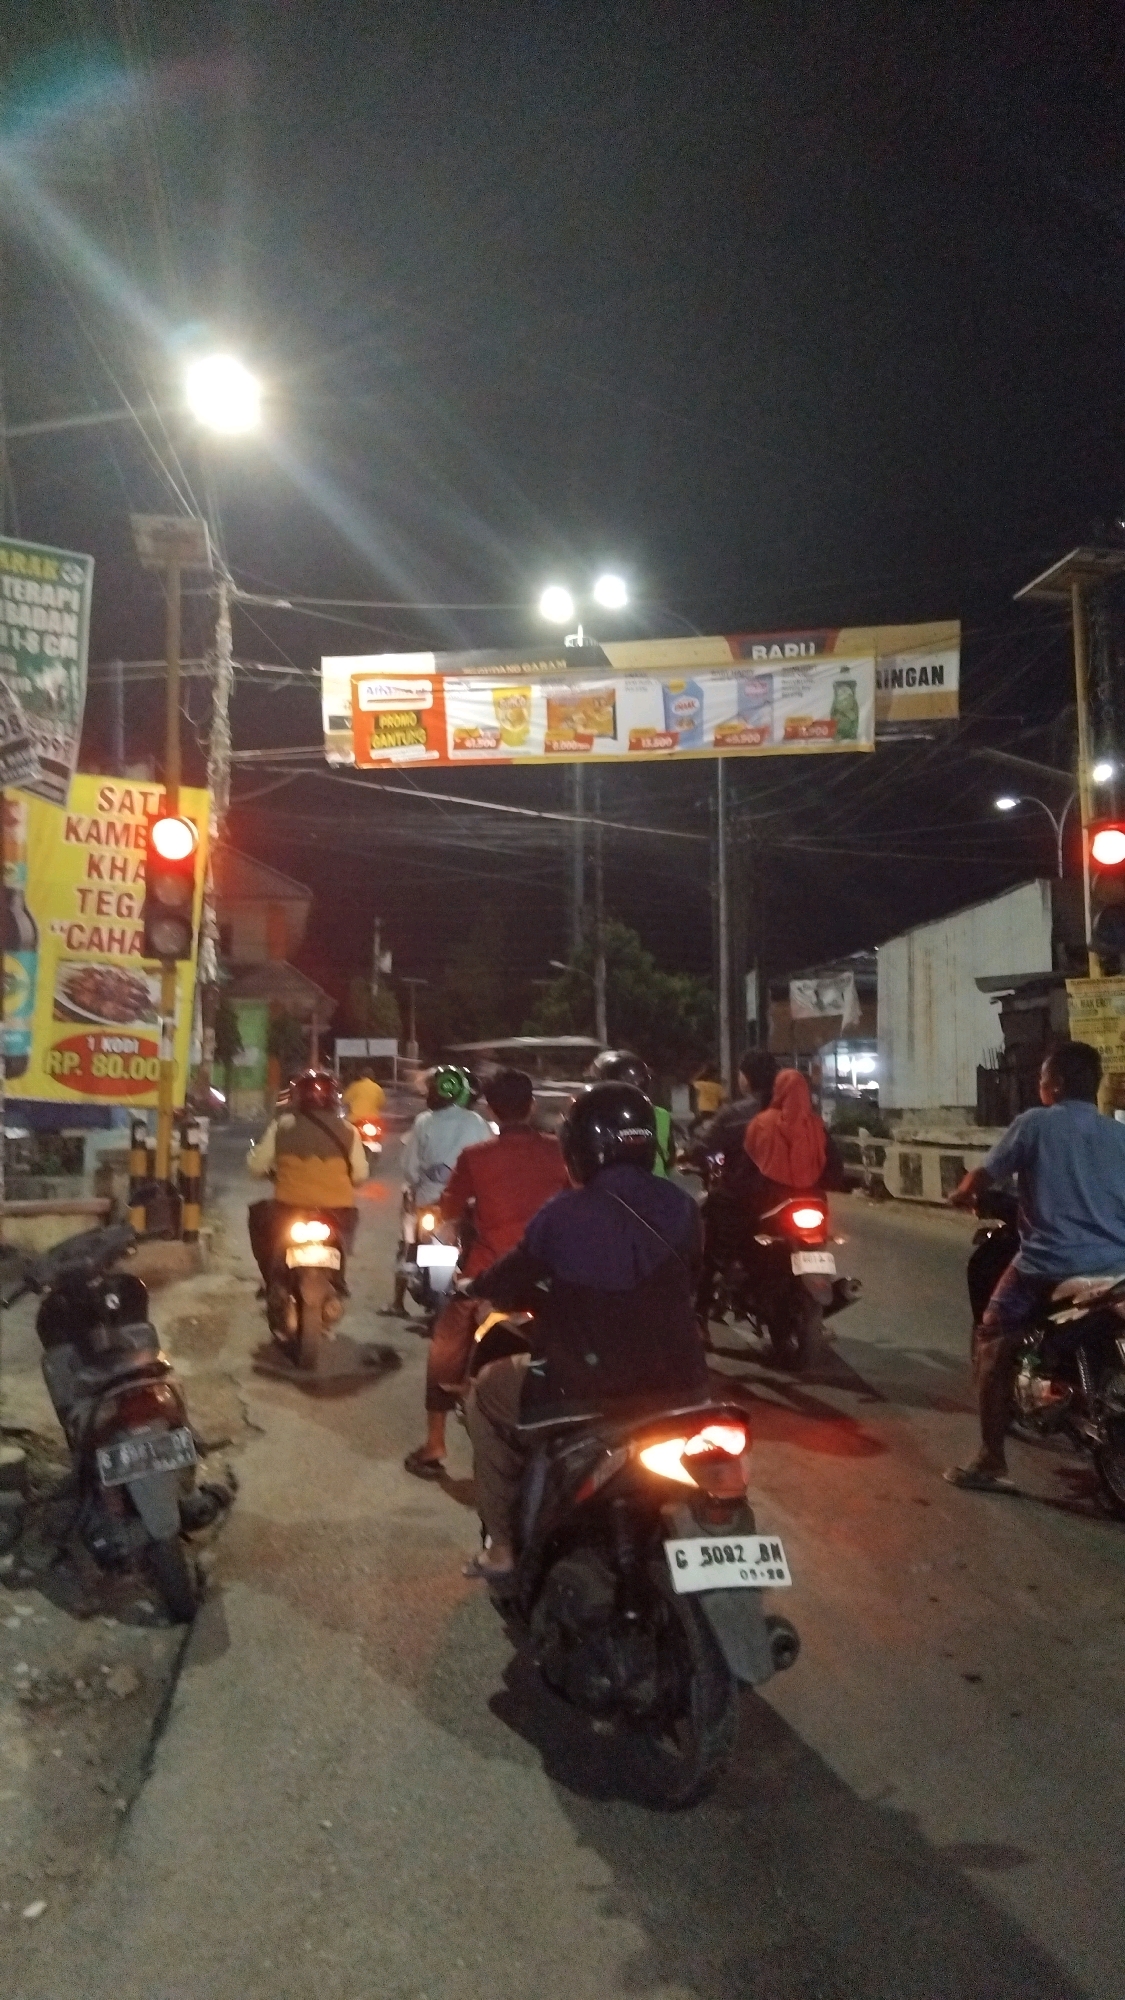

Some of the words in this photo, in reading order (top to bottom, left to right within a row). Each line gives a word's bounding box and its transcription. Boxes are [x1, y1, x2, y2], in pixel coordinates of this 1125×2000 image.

[2, 575, 80, 613] TERAPI
[65, 816, 147, 849] KAMB
[87, 853, 146, 883] KHA
[77, 888, 144, 919] TEG
[90, 1053, 160, 1082] 80.00
[675, 1549, 689, 1570] G
